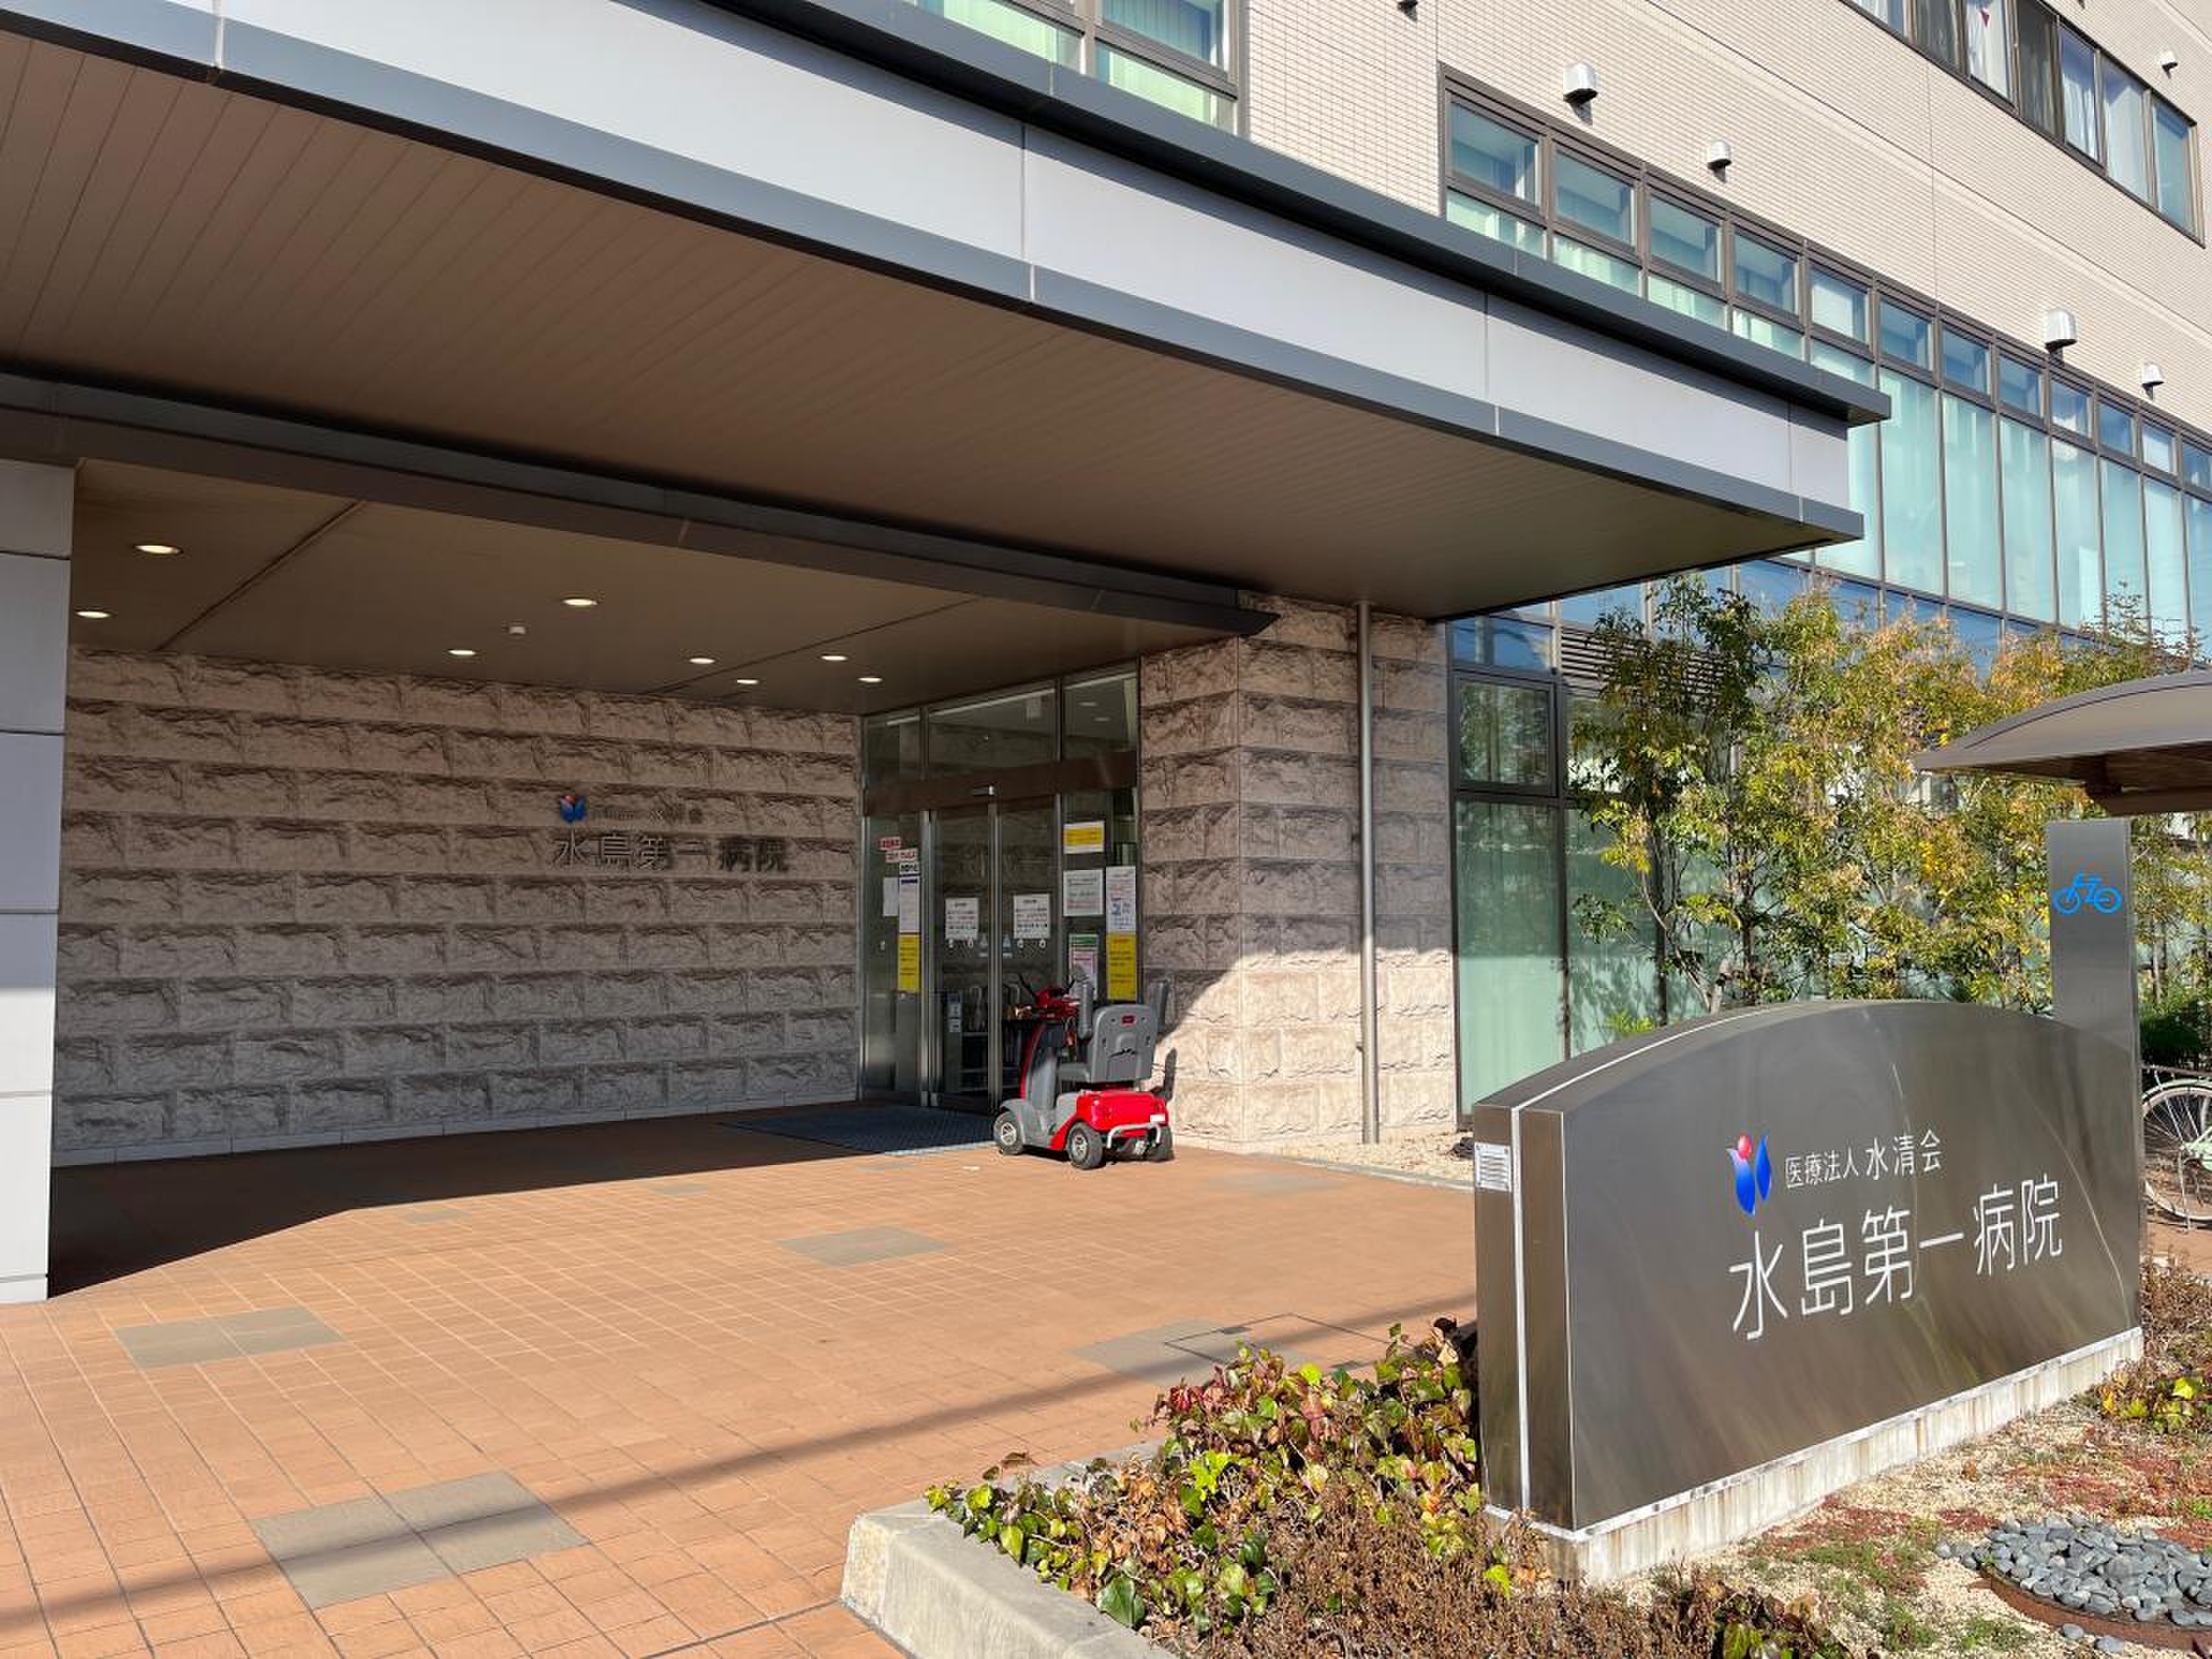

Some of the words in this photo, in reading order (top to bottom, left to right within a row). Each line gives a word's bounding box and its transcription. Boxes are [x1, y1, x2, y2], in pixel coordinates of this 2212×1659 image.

[1729, 1173, 2064, 1340] 水島第一病院
